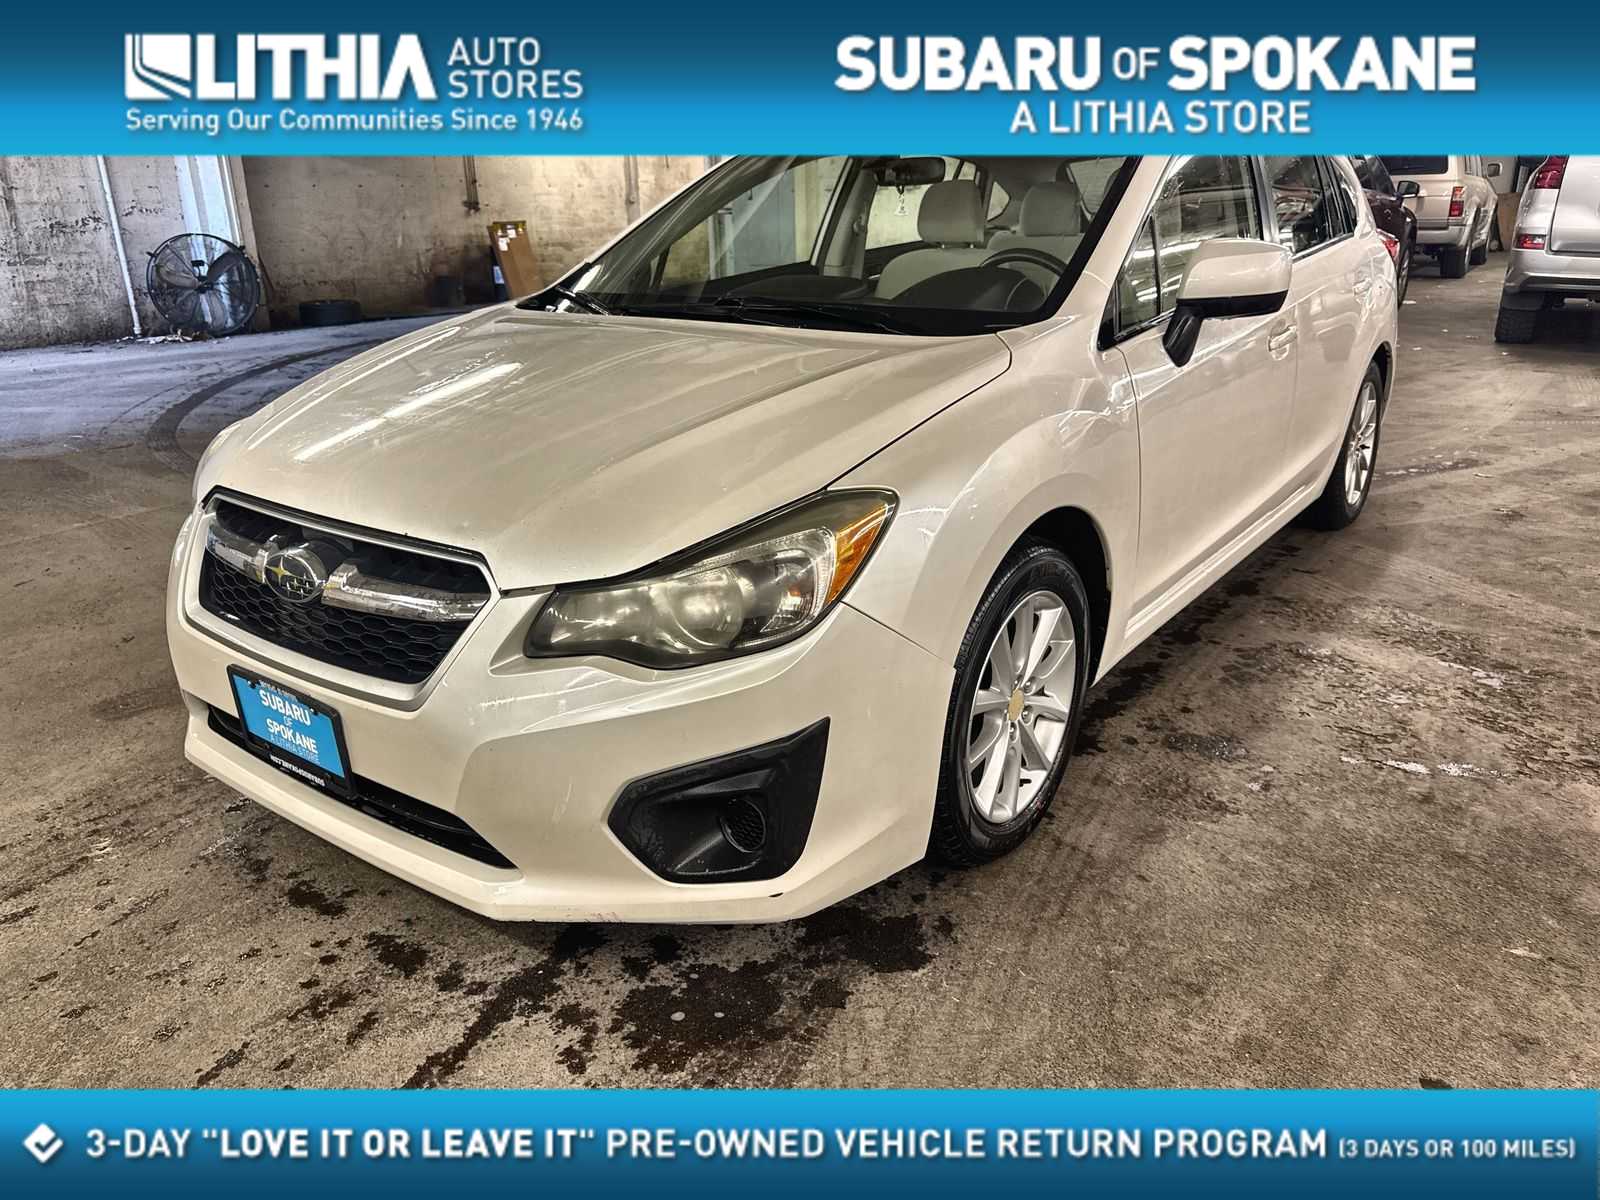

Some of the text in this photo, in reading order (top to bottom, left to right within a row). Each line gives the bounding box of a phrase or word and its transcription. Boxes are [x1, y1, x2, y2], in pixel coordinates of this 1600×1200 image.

[259, 689, 311, 726] SUBARU
[283, 715, 293, 727] OF
[266, 718, 318, 753] SPOKANE
